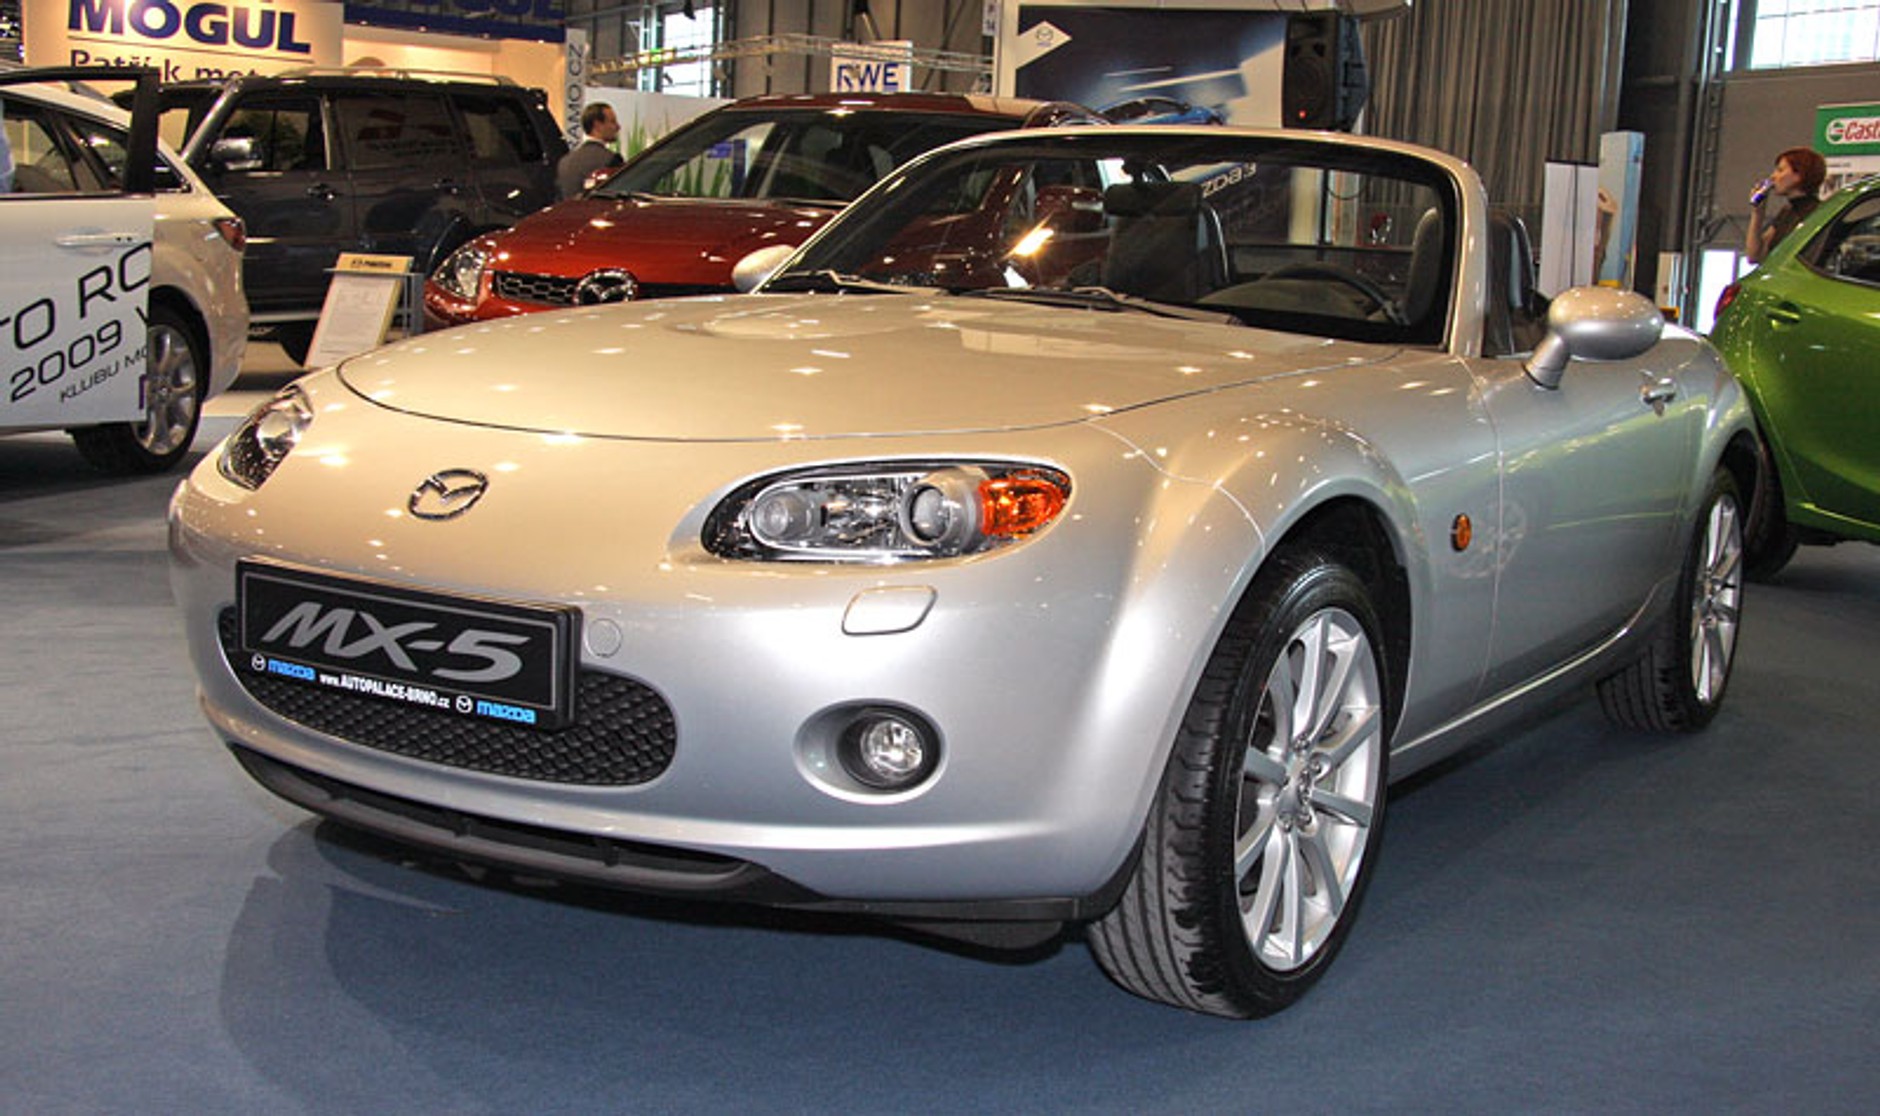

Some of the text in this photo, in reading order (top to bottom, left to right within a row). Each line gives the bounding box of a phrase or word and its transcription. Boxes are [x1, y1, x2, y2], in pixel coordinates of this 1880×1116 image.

[68, 0, 311, 54] MOGUL
[164, 59, 180, 82] k
[836, 63, 899, 88] RWE
[10, 319, 122, 402] 2009
[59, 362, 120, 402] KLUBU
[261, 601, 531, 683] MX-5
[268, 658, 316, 681] mazda
[476, 699, 537, 724] mazda
